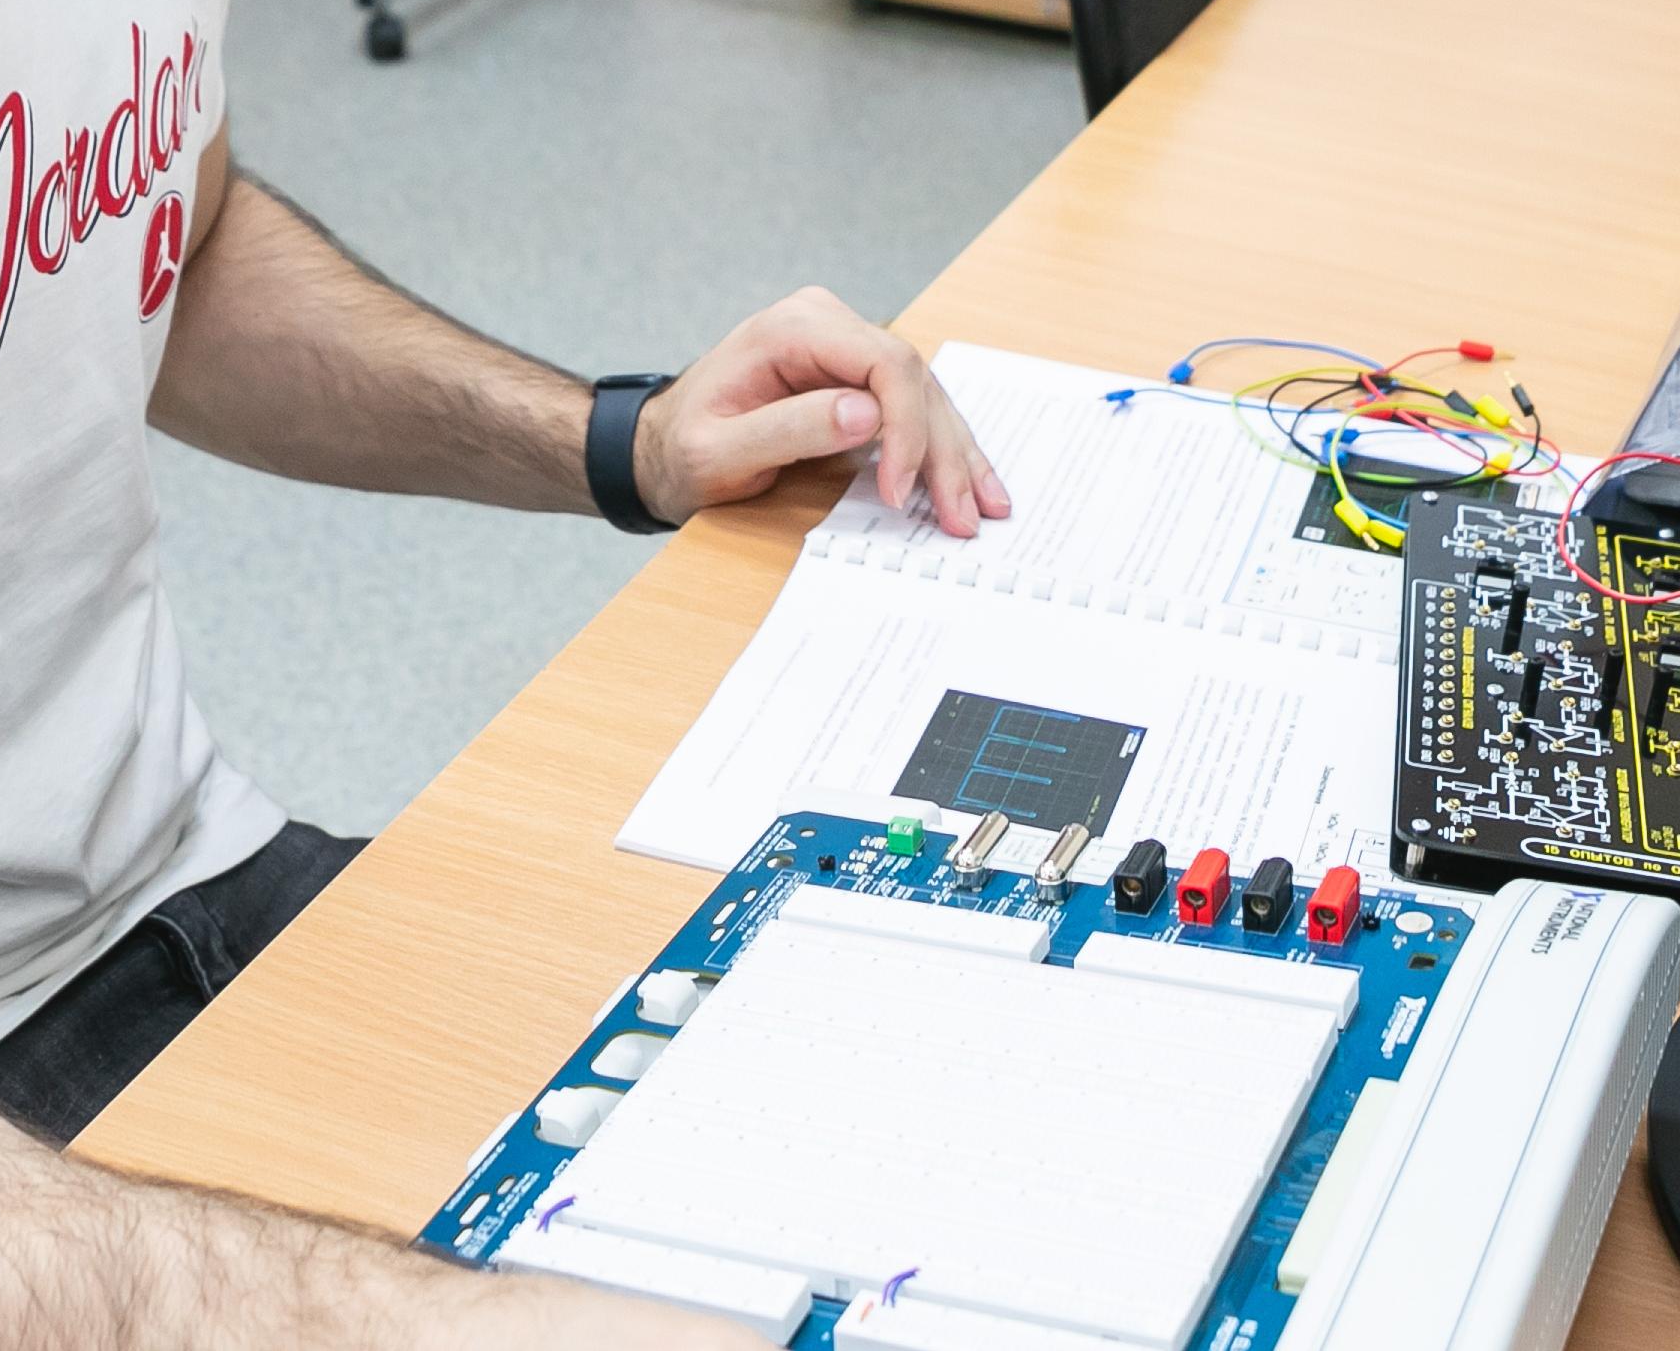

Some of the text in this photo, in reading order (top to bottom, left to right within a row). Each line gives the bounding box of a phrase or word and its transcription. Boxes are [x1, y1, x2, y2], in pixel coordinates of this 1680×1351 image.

[1570, 848, 1634, 867] ОПЫТОВ
[1643, 861, 1662, 872] по
[1531, 897, 1578, 954] INSTRUMENTS
[1561, 902, 1596, 941] NATIONAL
